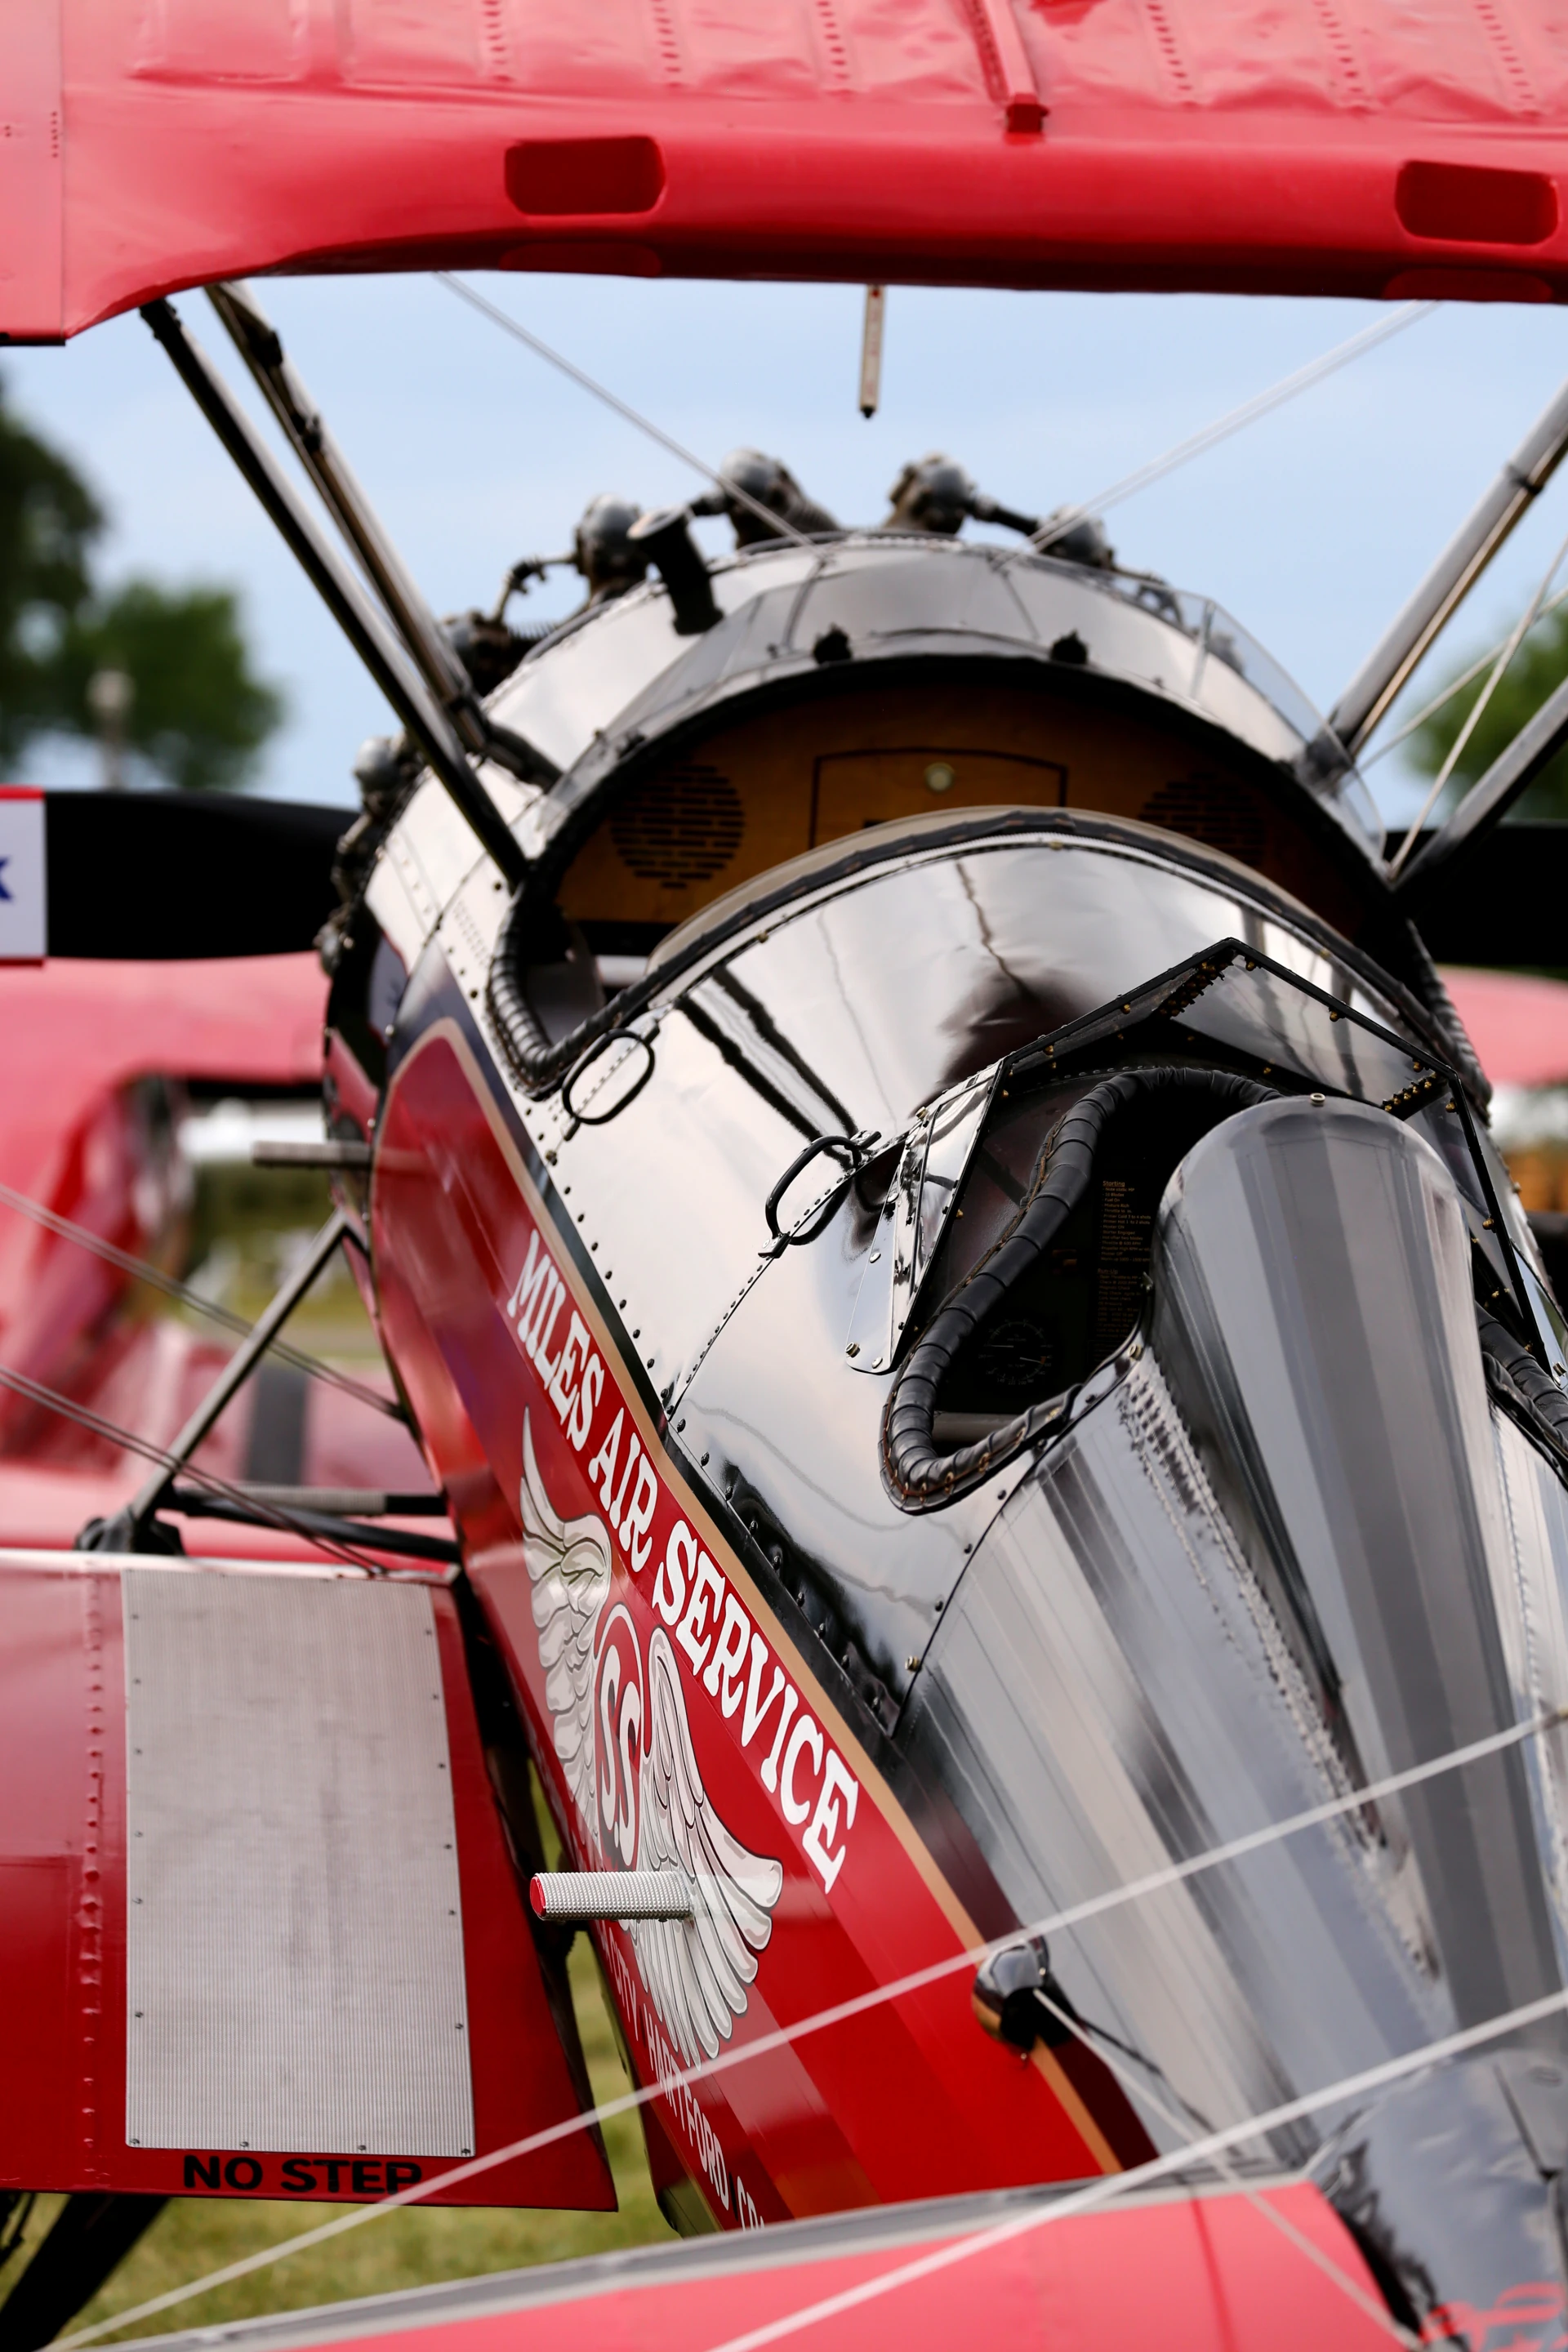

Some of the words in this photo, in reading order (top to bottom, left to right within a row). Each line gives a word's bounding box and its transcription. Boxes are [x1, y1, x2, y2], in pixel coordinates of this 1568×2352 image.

[507, 1228, 604, 1451] MILES
[588, 1407, 657, 1573] AIR
[653, 1519, 858, 1895] SERVICE
[184, 2154, 263, 2189] NO
[281, 2158, 422, 2195] STEP
[644, 2003, 729, 2211] HARTFORD
